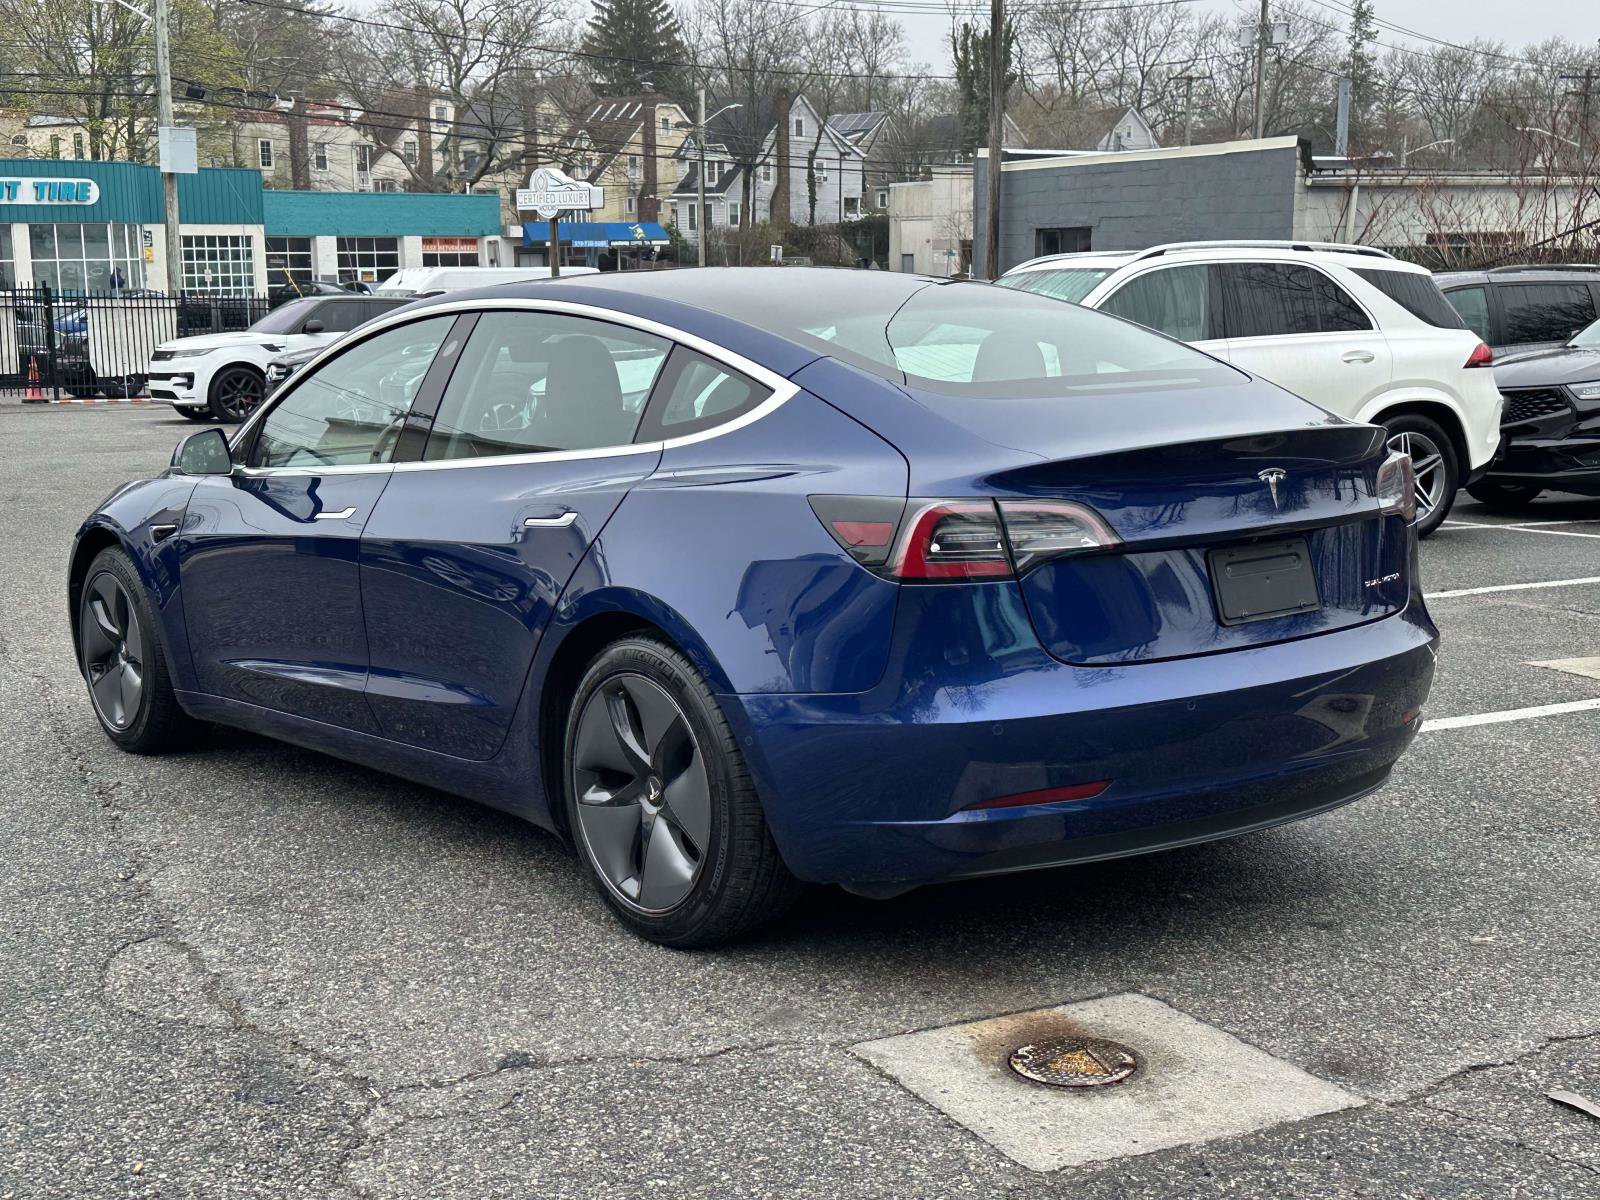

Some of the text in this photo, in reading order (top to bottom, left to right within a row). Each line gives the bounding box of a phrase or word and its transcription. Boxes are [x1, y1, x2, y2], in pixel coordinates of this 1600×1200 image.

[33, 181, 91, 201] TIRE
[518, 191, 588, 204] CERTIFIED LUXURY
[624, 648, 675, 681] MICHELIN
